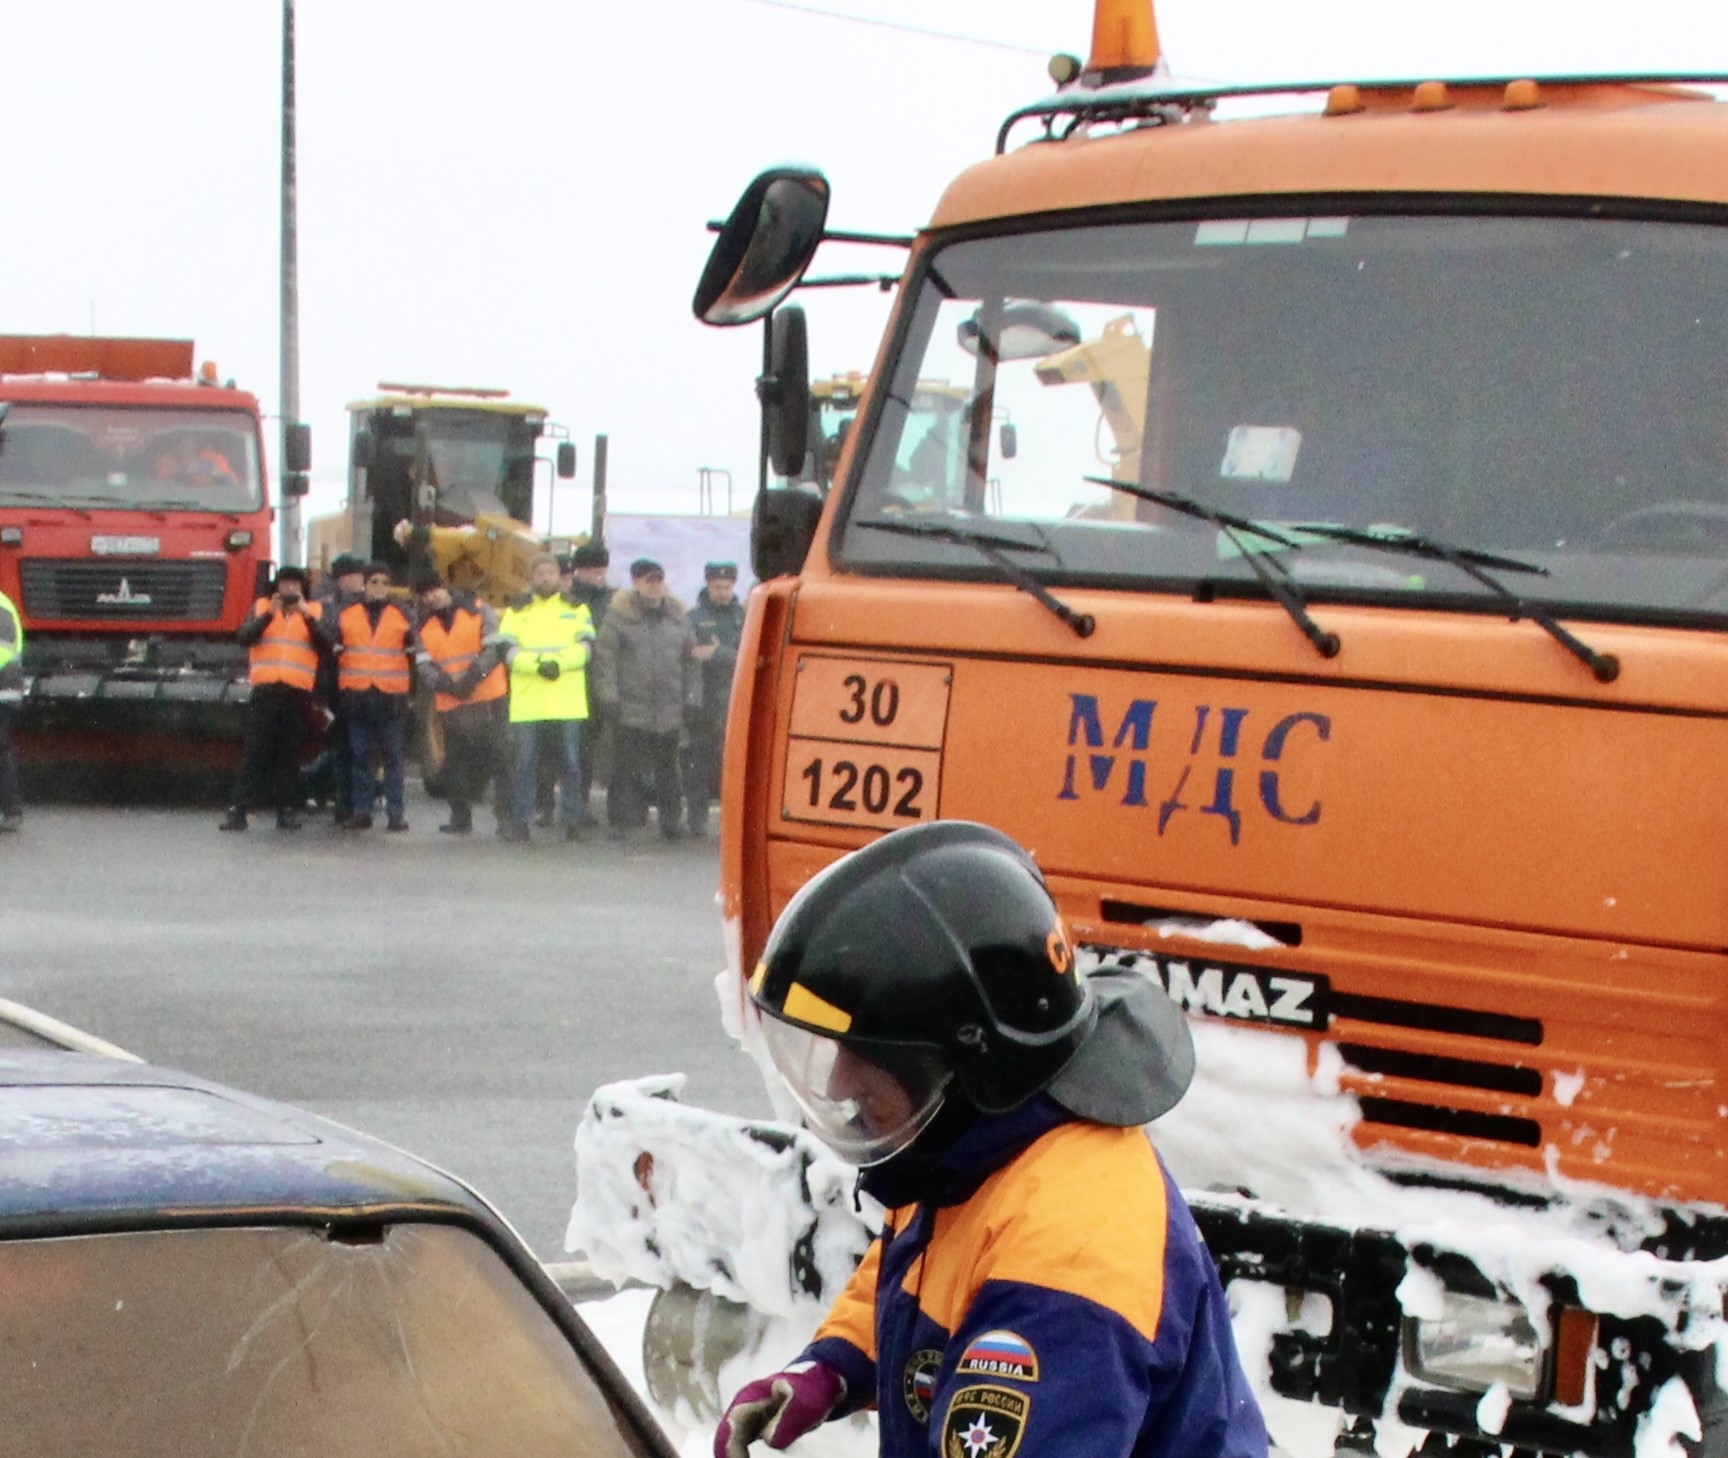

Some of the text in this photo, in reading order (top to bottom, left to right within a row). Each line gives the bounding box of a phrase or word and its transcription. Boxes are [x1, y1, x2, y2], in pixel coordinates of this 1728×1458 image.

[838, 674, 899, 728] 30
[801, 757, 924, 818] 1202
[1057, 692, 1332, 846] МДС
[969, 1358, 1024, 1376] RUSSIA
[980, 1391, 1023, 1414] РОССИИ
